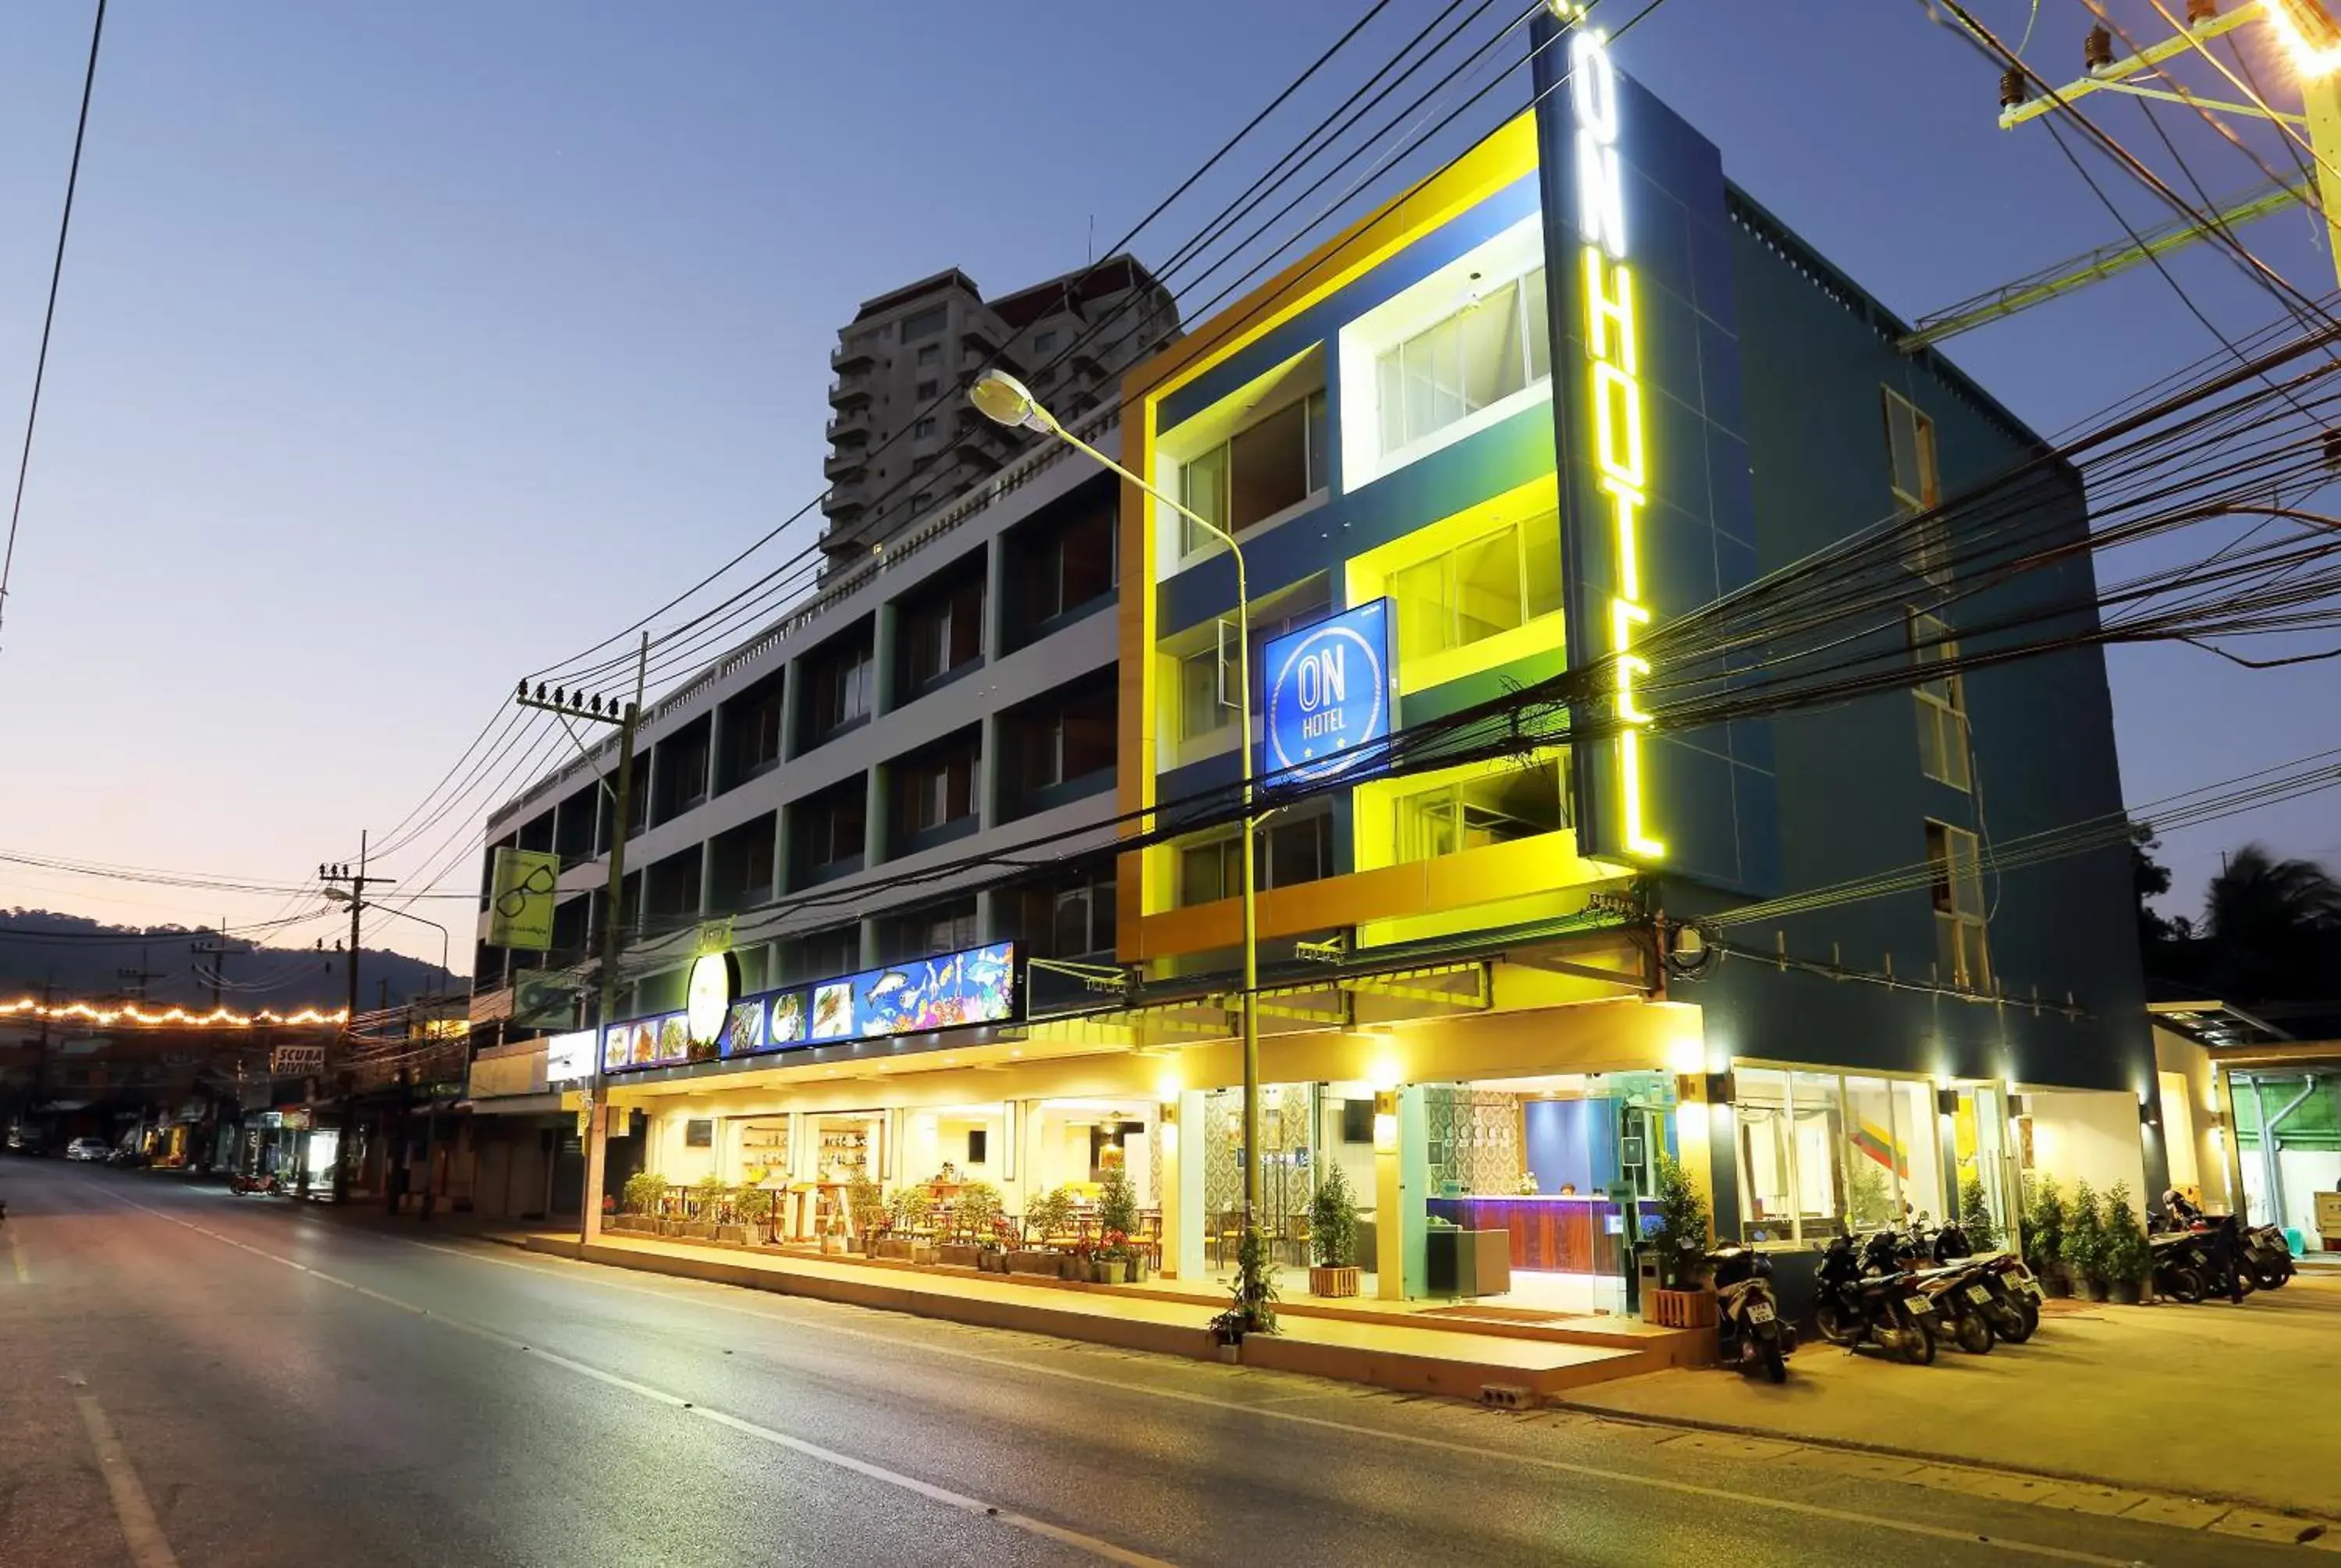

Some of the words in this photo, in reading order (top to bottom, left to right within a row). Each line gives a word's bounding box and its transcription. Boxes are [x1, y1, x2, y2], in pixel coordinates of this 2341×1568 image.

[1570, 31, 1625, 259] ON
[1584, 245, 1664, 857] HOTEL
[1298, 644, 1346, 711] ON
[1304, 708, 1346, 740] HOTEL
[278, 1048, 321, 1061] SCUBA
